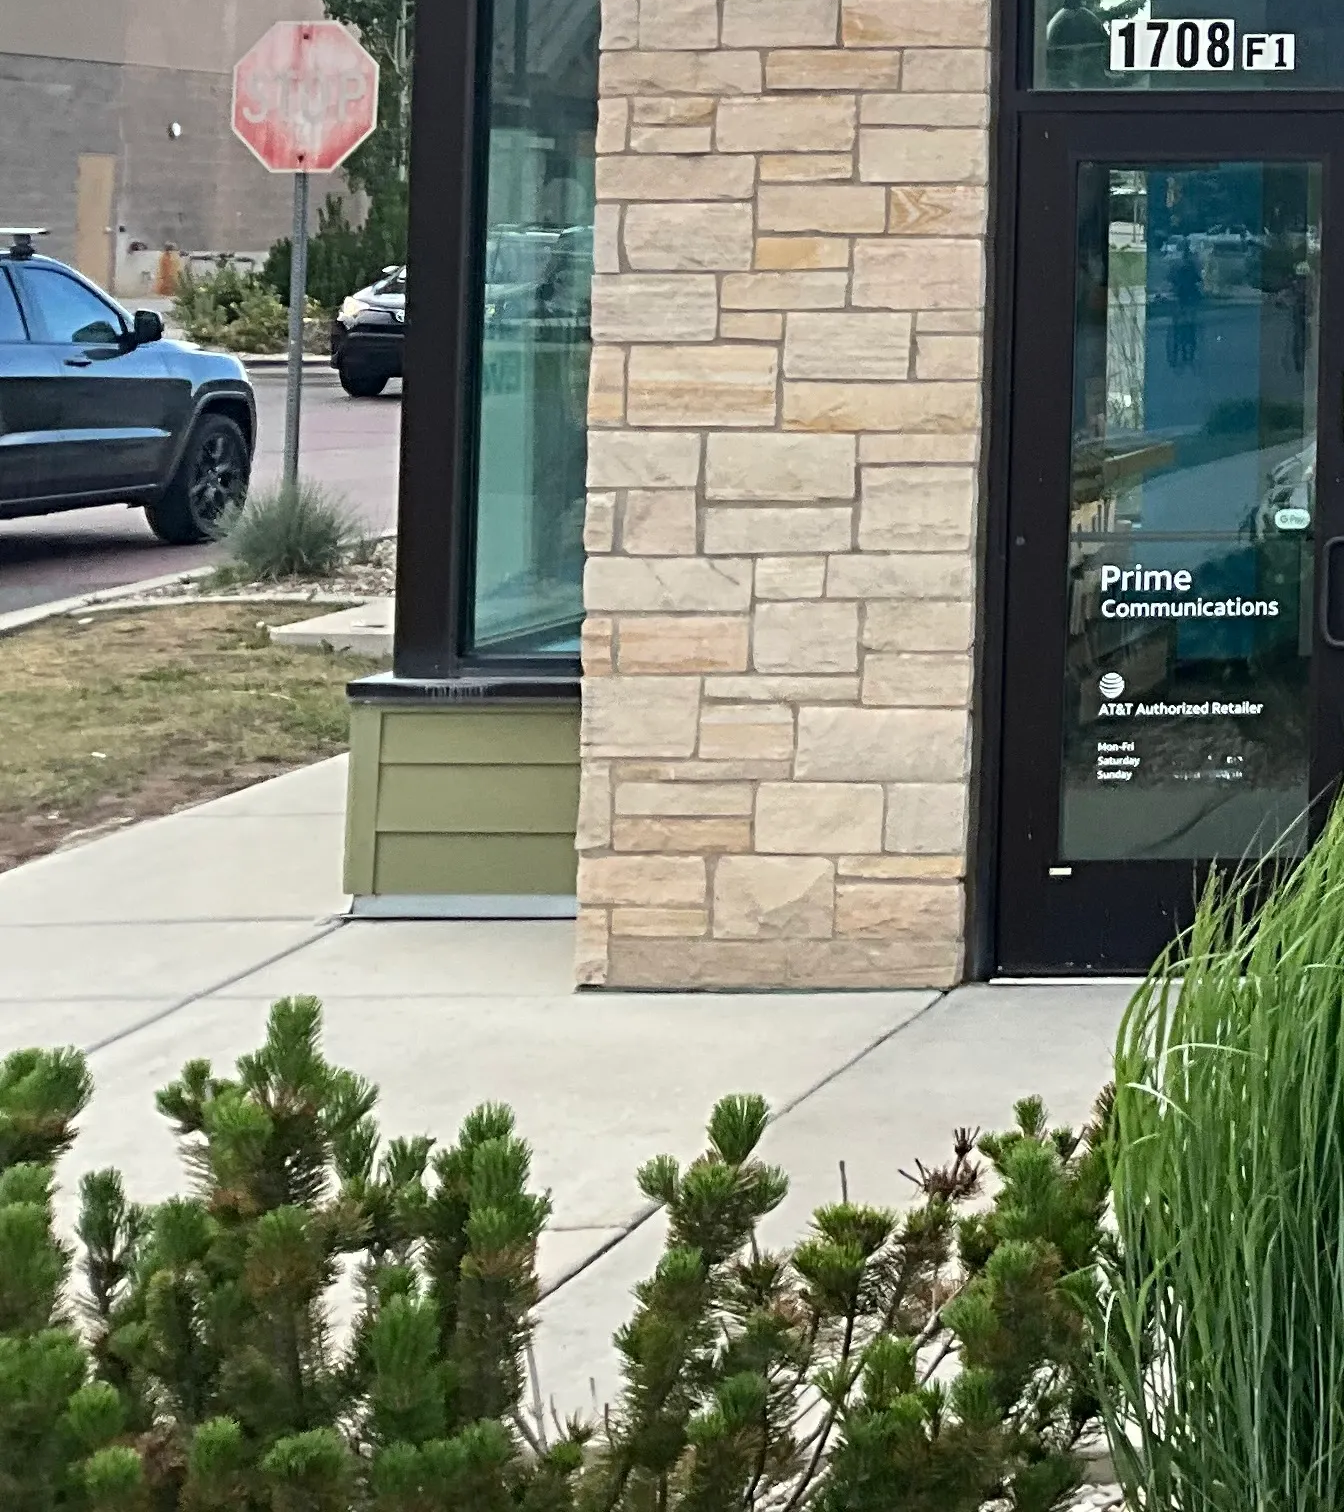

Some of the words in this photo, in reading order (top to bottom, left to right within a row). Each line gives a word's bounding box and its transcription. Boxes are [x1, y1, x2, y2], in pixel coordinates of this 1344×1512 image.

[1116, 21, 1230, 69] 1708
[1246, 37, 1288, 68] F1
[243, 67, 367, 123] STOP
[1100, 564, 1192, 592] Prime
[1101, 597, 1279, 618] Communications
[1098, 703, 1134, 716] AT&T
[1135, 701, 1209, 716] Authorized
[1211, 701, 1264, 715] Retailer
[1097, 742, 1135, 752] Mon-Fri
[1097, 755, 1141, 767] Saturday
[1097, 769, 1133, 781] Sunday
